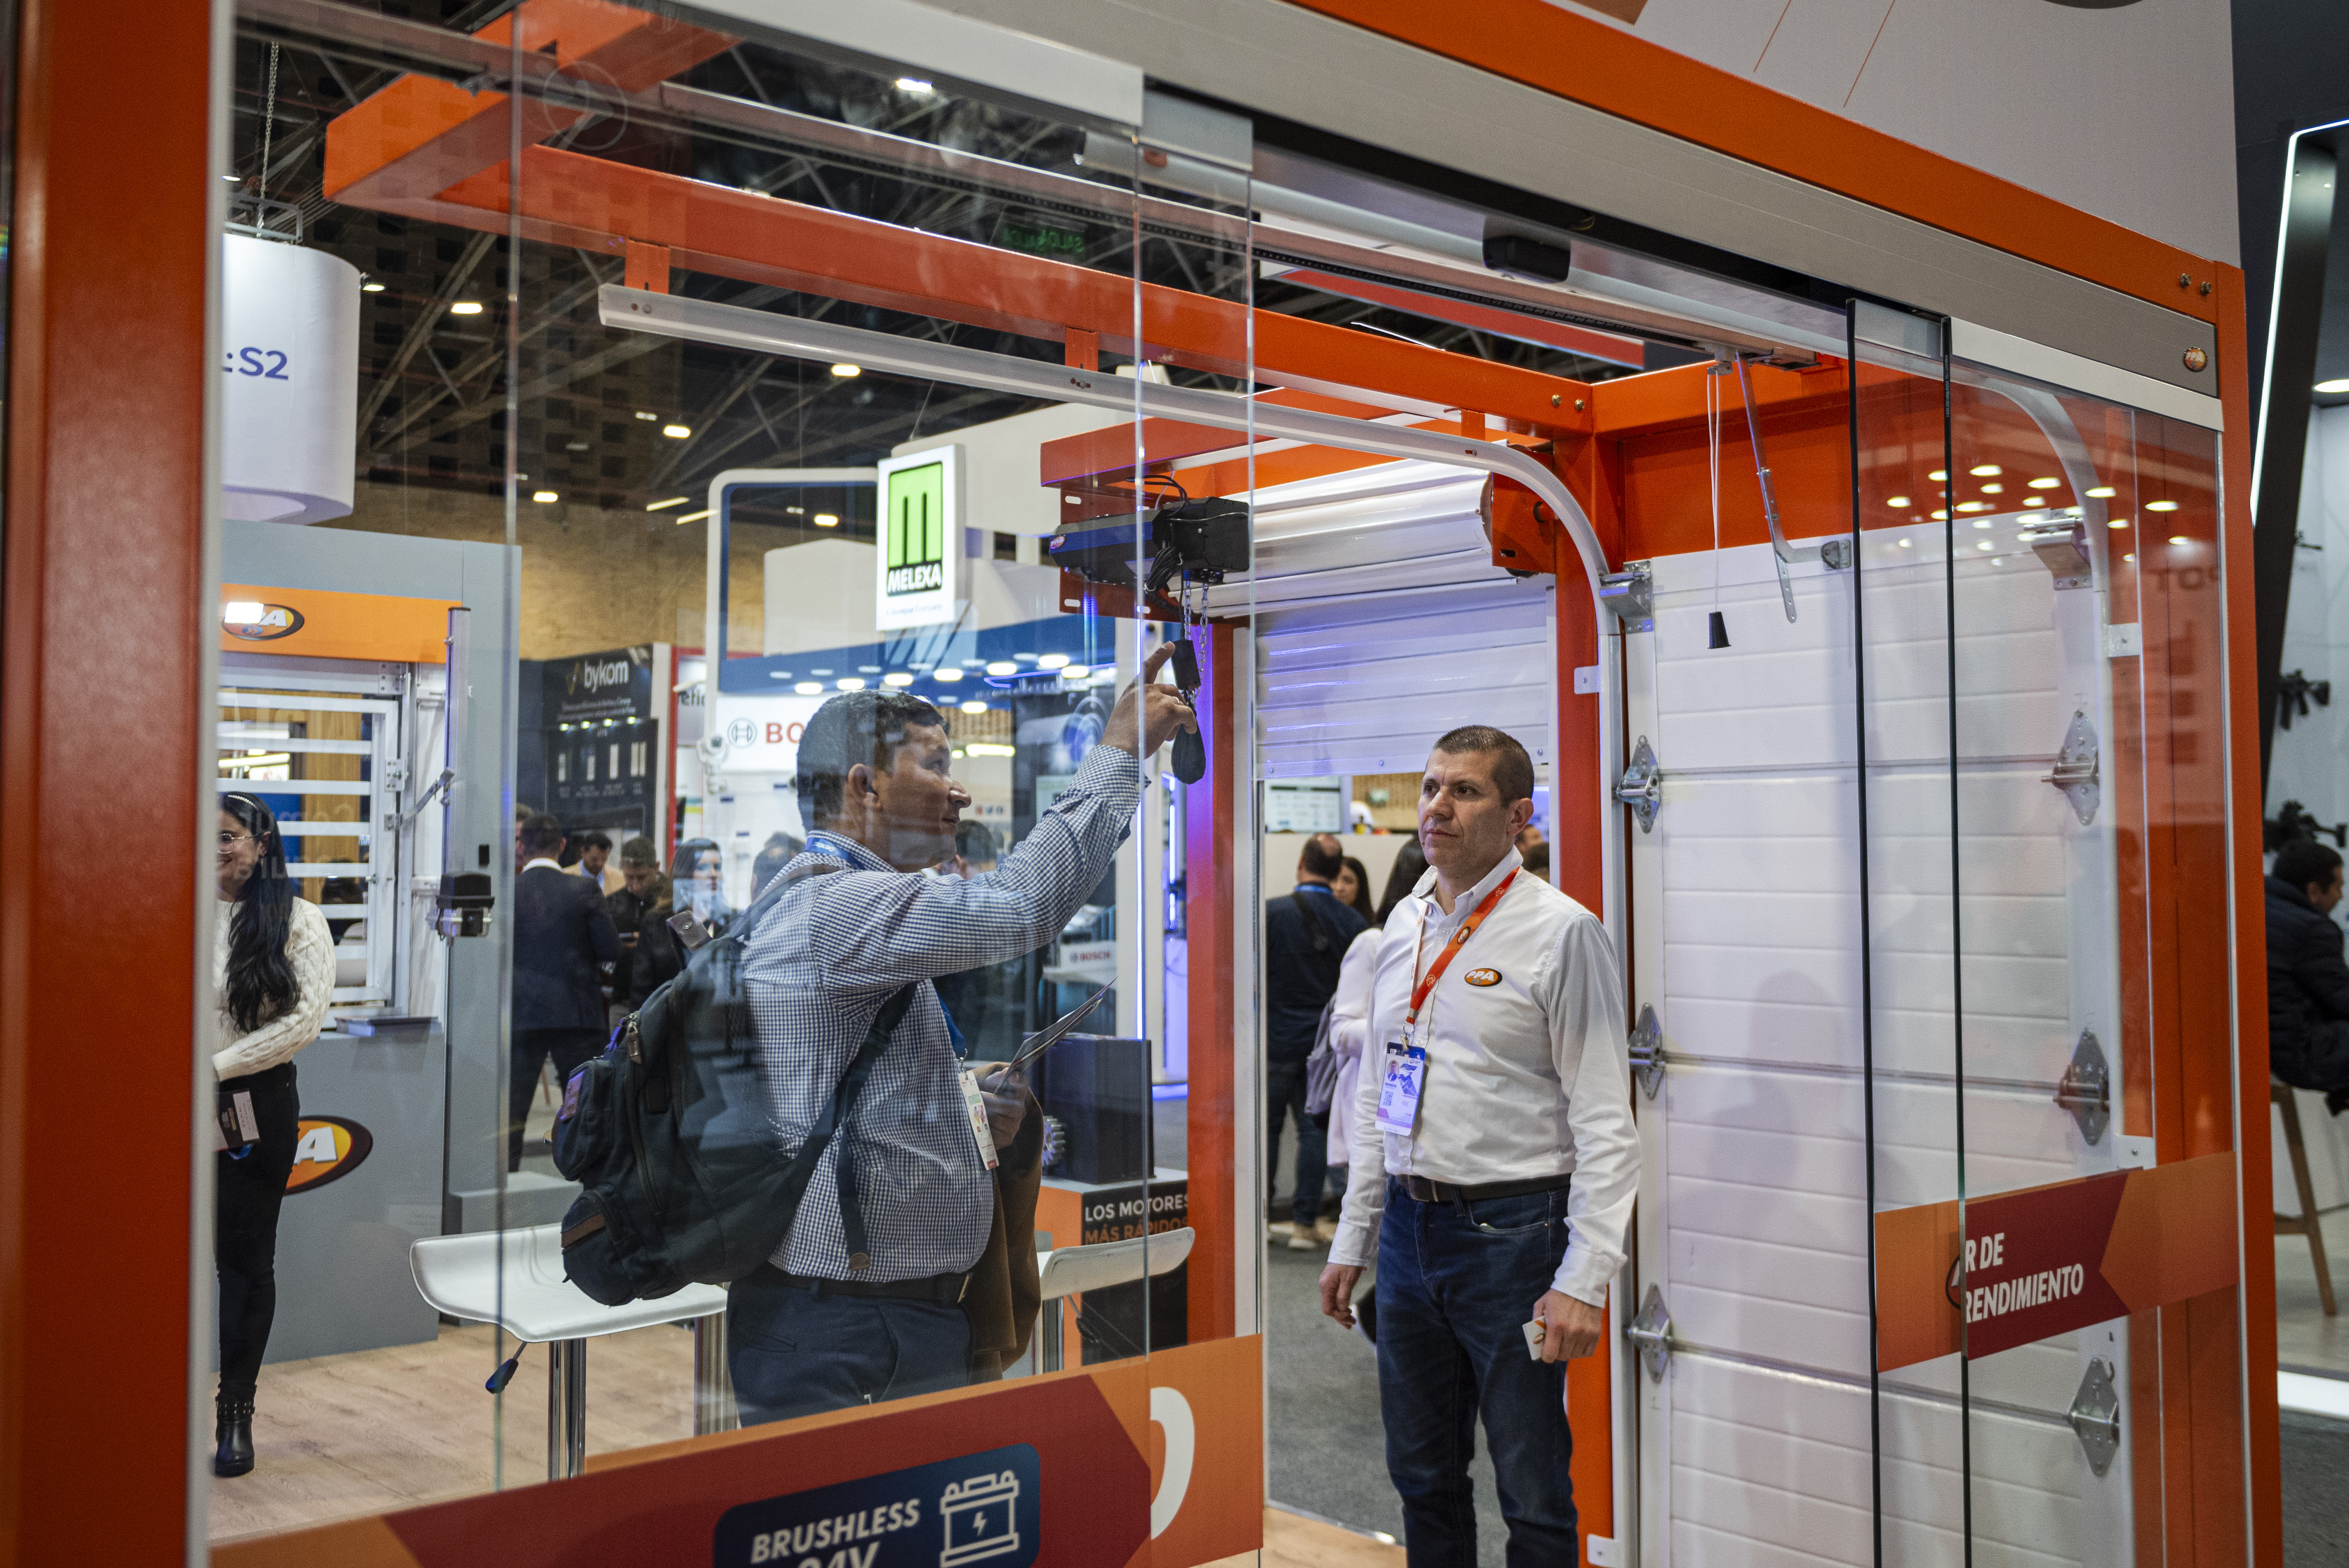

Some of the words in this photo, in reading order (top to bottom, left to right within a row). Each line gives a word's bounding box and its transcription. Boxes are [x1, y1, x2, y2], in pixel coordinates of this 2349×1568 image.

[888, 563, 942, 593] MELEXA
[916, 604, 942, 613] Company
[584, 659, 628, 693] bykom
[1467, 971, 1494, 981] PPA
[1085, 1203, 1115, 1222] LOS
[1085, 1223, 1119, 1245] MÁS
[1980, 1232, 2005, 1269] DE
[1966, 1263, 2084, 1323] RENDIMIENTO
[750, 1498, 921, 1565] BRUSHLESS
